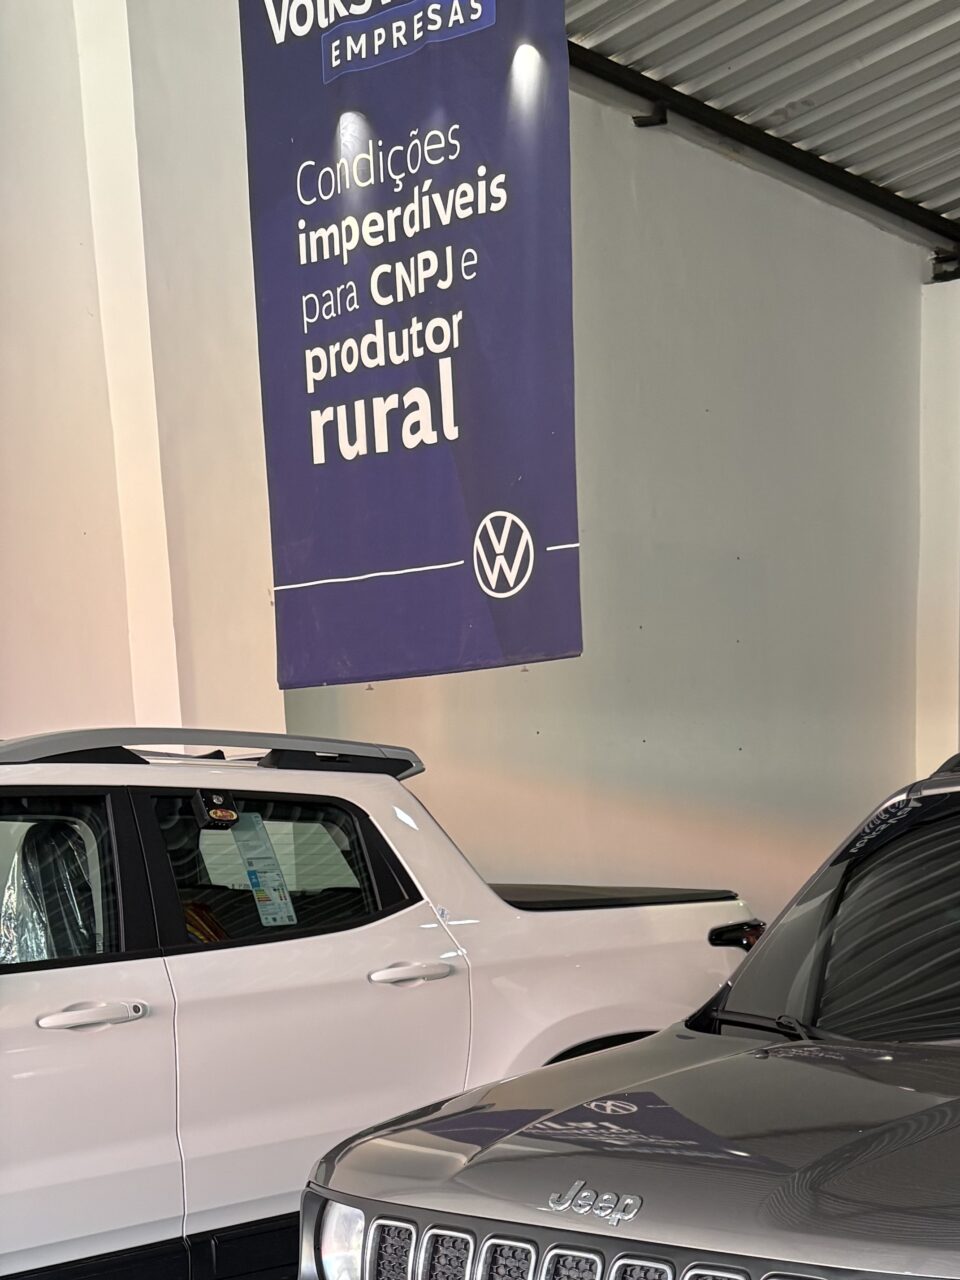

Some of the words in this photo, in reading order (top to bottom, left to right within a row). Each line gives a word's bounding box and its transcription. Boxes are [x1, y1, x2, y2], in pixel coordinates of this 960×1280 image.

[331, 0, 482, 67] EMPRESAS
[297, 124, 460, 205] Condições
[298, 165, 507, 265] imperdíveis
[302, 281, 359, 334] para
[370, 246, 453, 306] CNPJ
[461, 248, 478, 280] e
[305, 310, 463, 393] produtor
[310, 357, 459, 464] rural
[549, 1180, 643, 1226] Jeep
